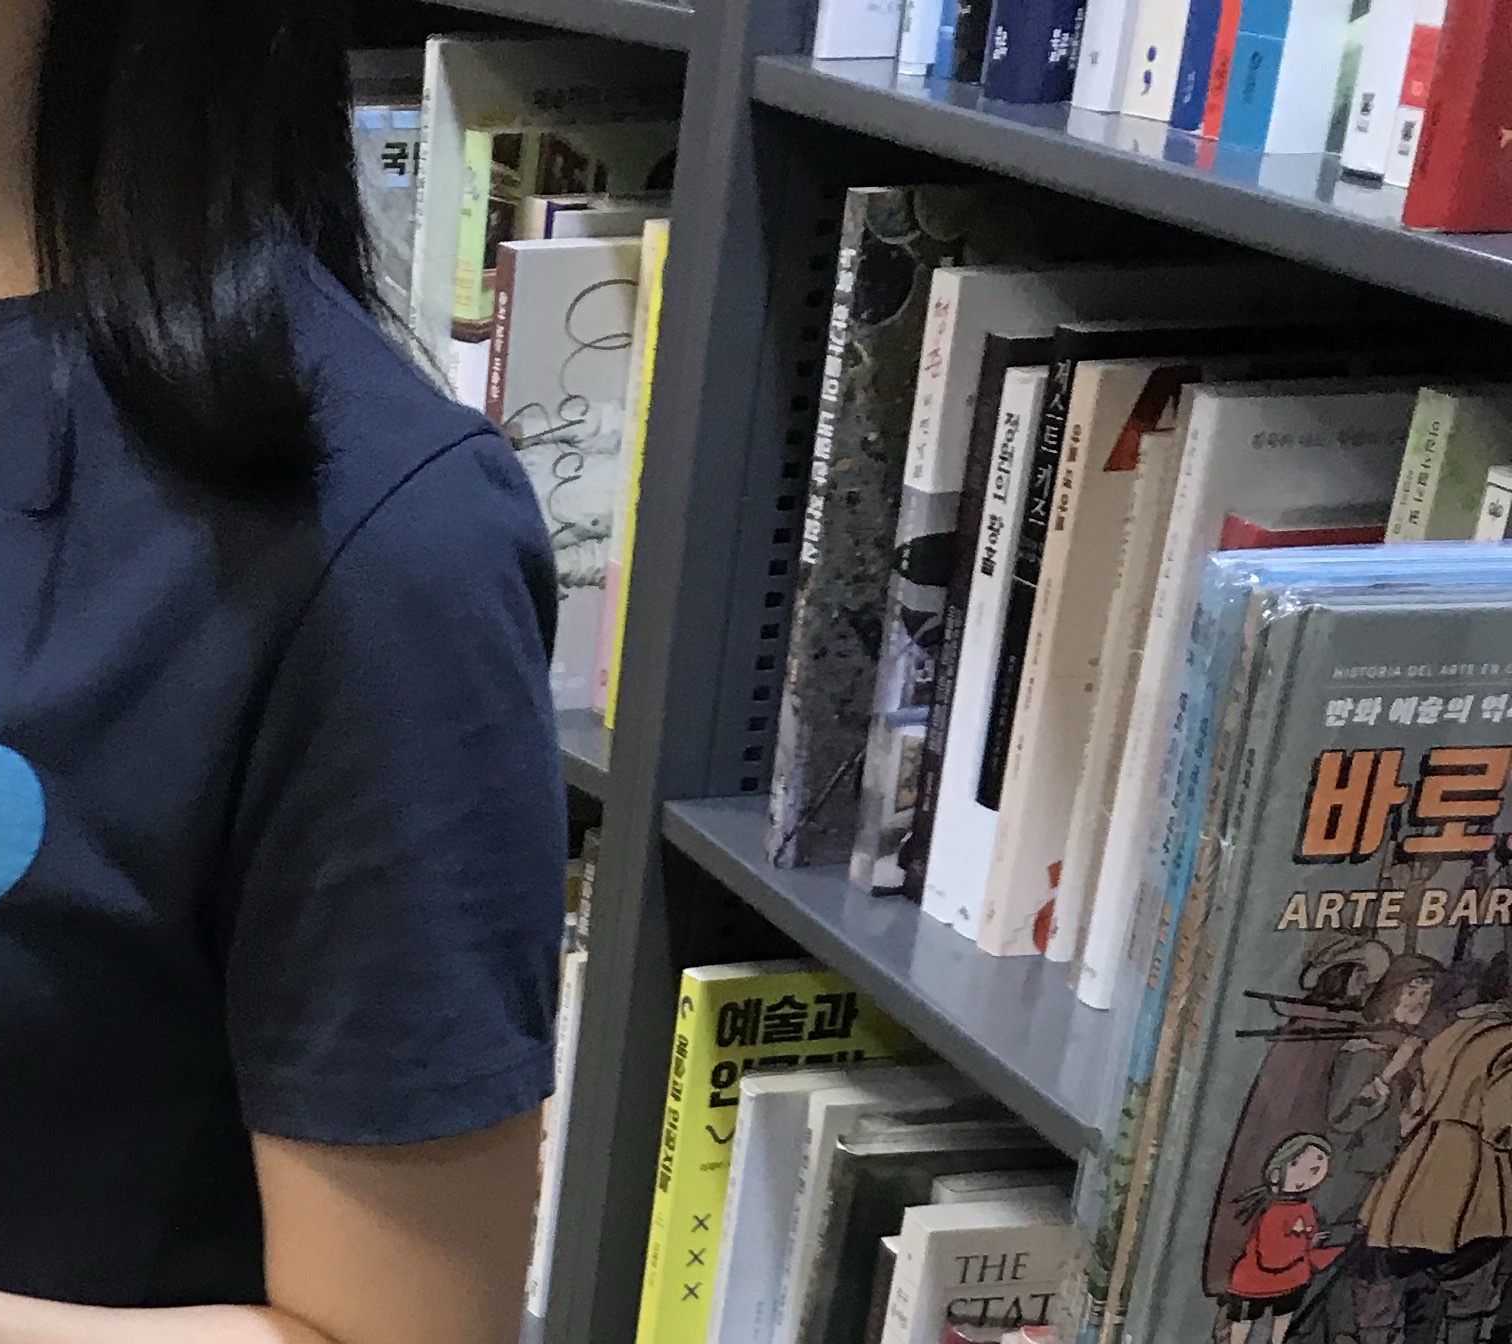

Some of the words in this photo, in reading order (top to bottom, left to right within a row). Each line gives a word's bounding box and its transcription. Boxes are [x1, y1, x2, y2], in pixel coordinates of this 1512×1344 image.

[1325, 695, 1384, 728] 만화
[1480, 693, 1512, 725] 역
[1292, 744, 1512, 865] 바로
[1277, 887, 1406, 933] ARTE
[1415, 886, 1512, 930] BAR
[714, 991, 859, 1048] 예술과
[955, 1250, 1031, 1285] THE
